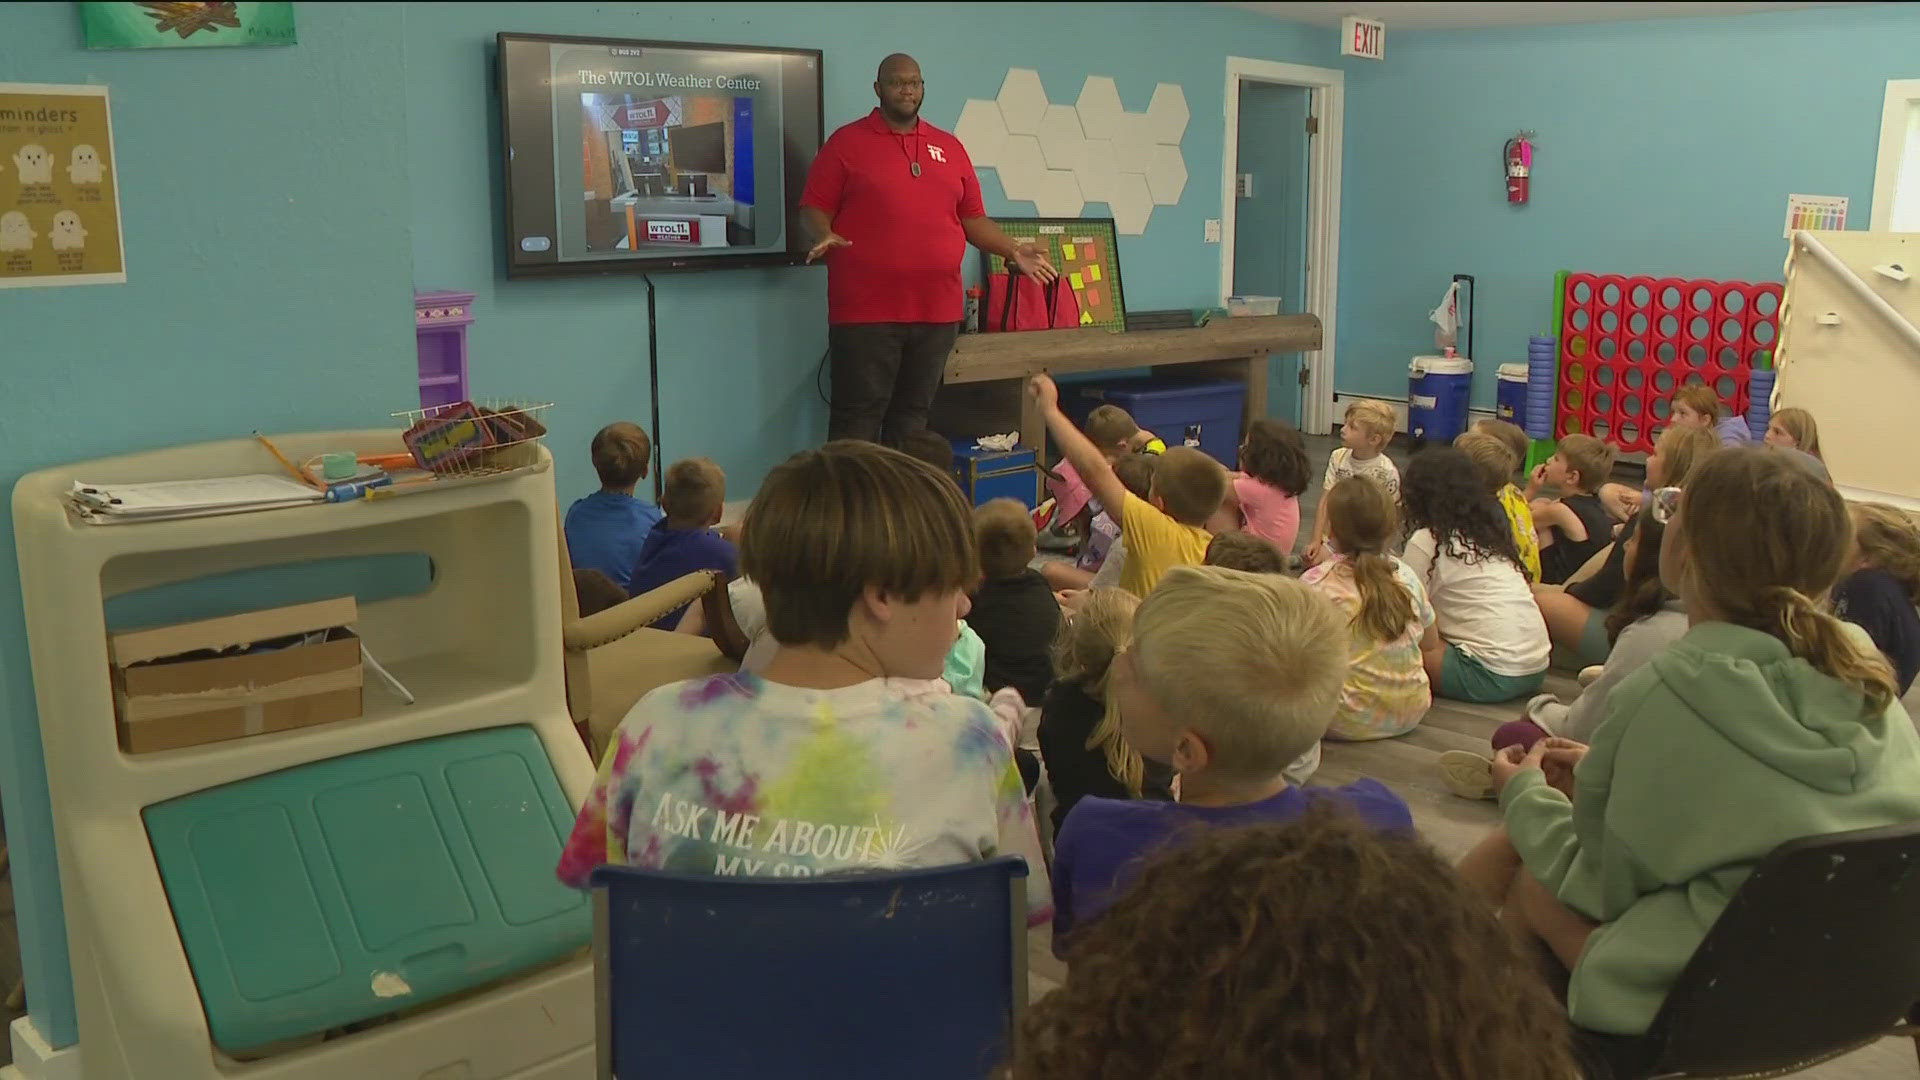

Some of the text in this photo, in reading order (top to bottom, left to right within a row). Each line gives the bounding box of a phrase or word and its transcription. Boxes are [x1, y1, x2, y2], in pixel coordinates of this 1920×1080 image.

[1355, 22, 1381, 56] EXIT
[578, 70, 761, 91] The WTOL Weather Center
[651, 792, 879, 862] ASK ME ABOUT
[714, 854, 765, 877] MY
